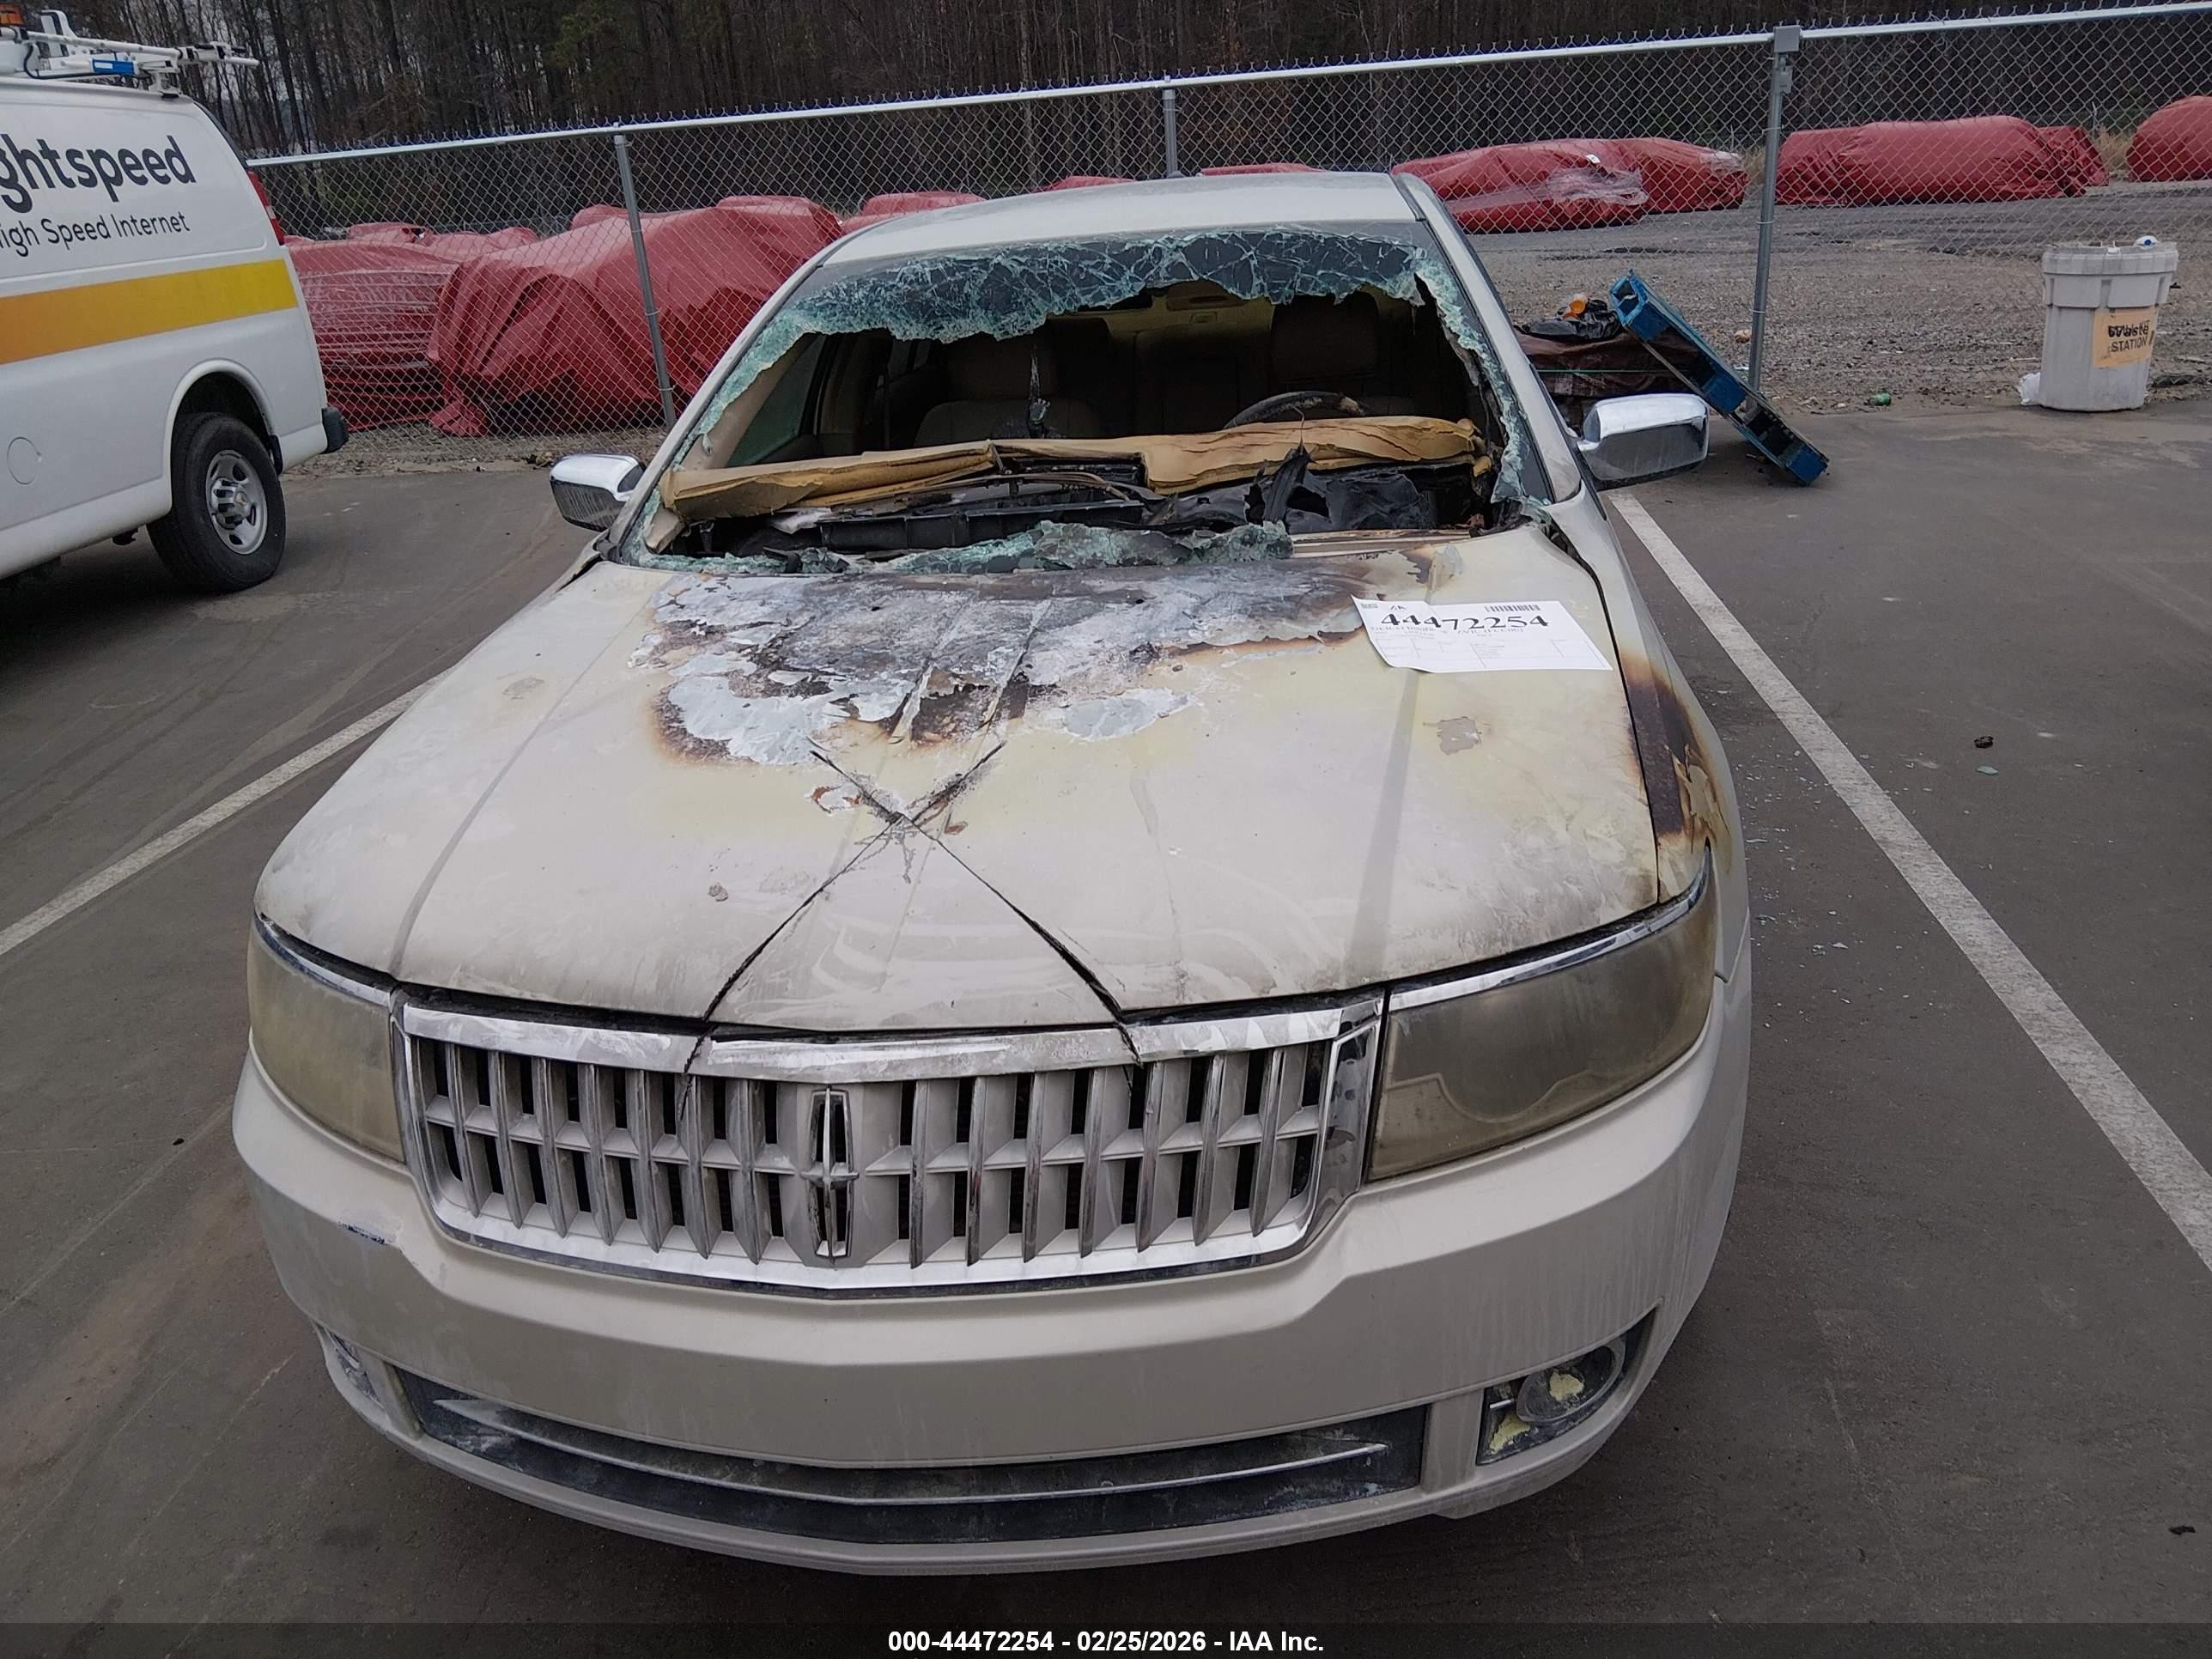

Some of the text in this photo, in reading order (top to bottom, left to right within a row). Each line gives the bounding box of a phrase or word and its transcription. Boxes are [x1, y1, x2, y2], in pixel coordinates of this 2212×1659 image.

[0, 211, 191, 257] igh Speed Internet
[2111, 335, 2148, 352] STATION
[1381, 613, 1549, 631] 44472254
